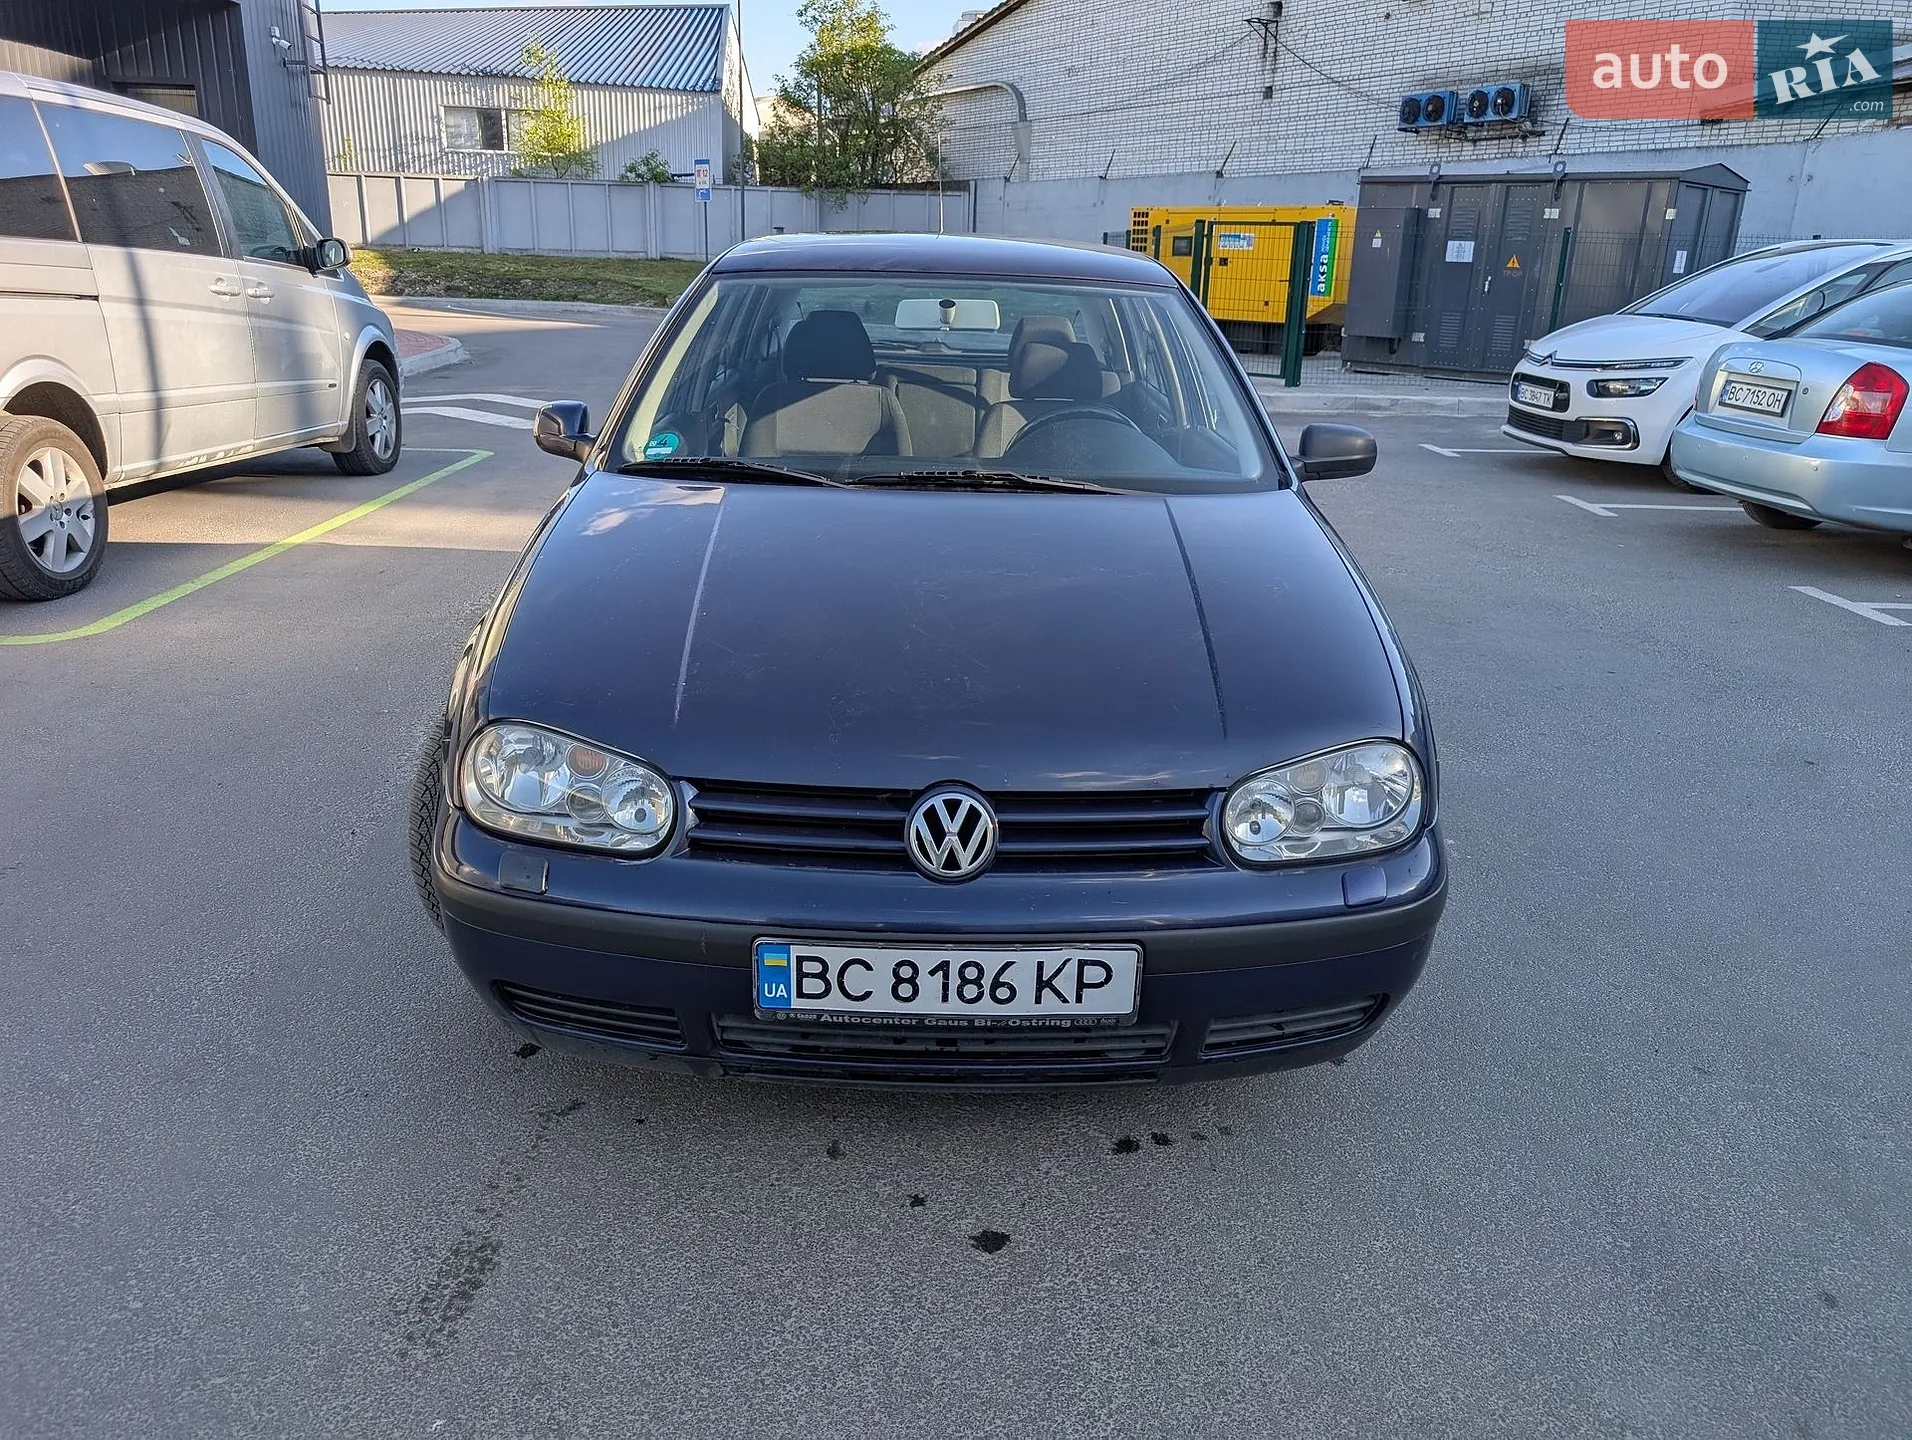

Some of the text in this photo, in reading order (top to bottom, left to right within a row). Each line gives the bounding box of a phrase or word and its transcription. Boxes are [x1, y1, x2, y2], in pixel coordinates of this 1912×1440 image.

[1316, 254, 1329, 293] aksa
[1727, 386, 1784, 410] BC 7152 OH
[764, 983, 788, 998] UA
[795, 955, 1114, 1005] BC 8186 KP
[820, 1013, 919, 1026] Autocenter
[924, 1017, 969, 1027] Gaus
